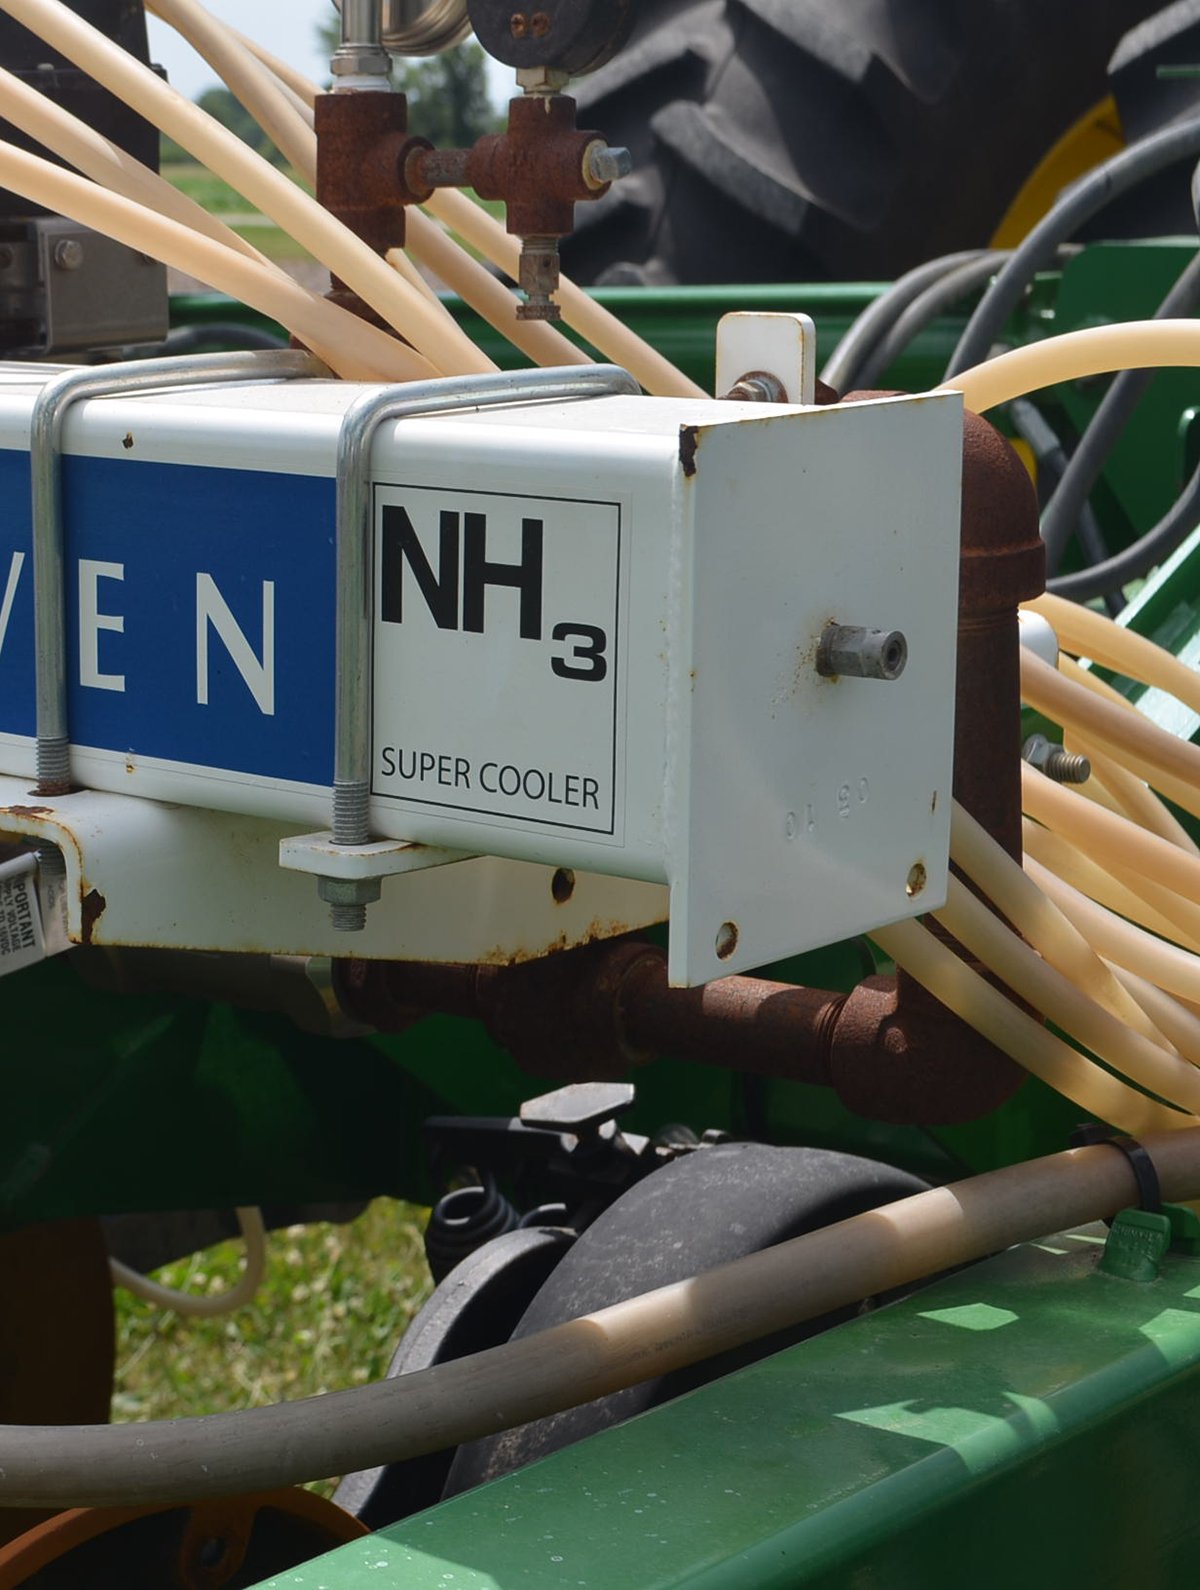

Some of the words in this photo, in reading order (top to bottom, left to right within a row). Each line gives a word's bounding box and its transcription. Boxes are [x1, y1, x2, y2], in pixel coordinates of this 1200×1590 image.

[381, 746, 471, 790] SUPER
[479, 761, 600, 811] COOLER
[6, 909, 23, 953] VOLTAGE
